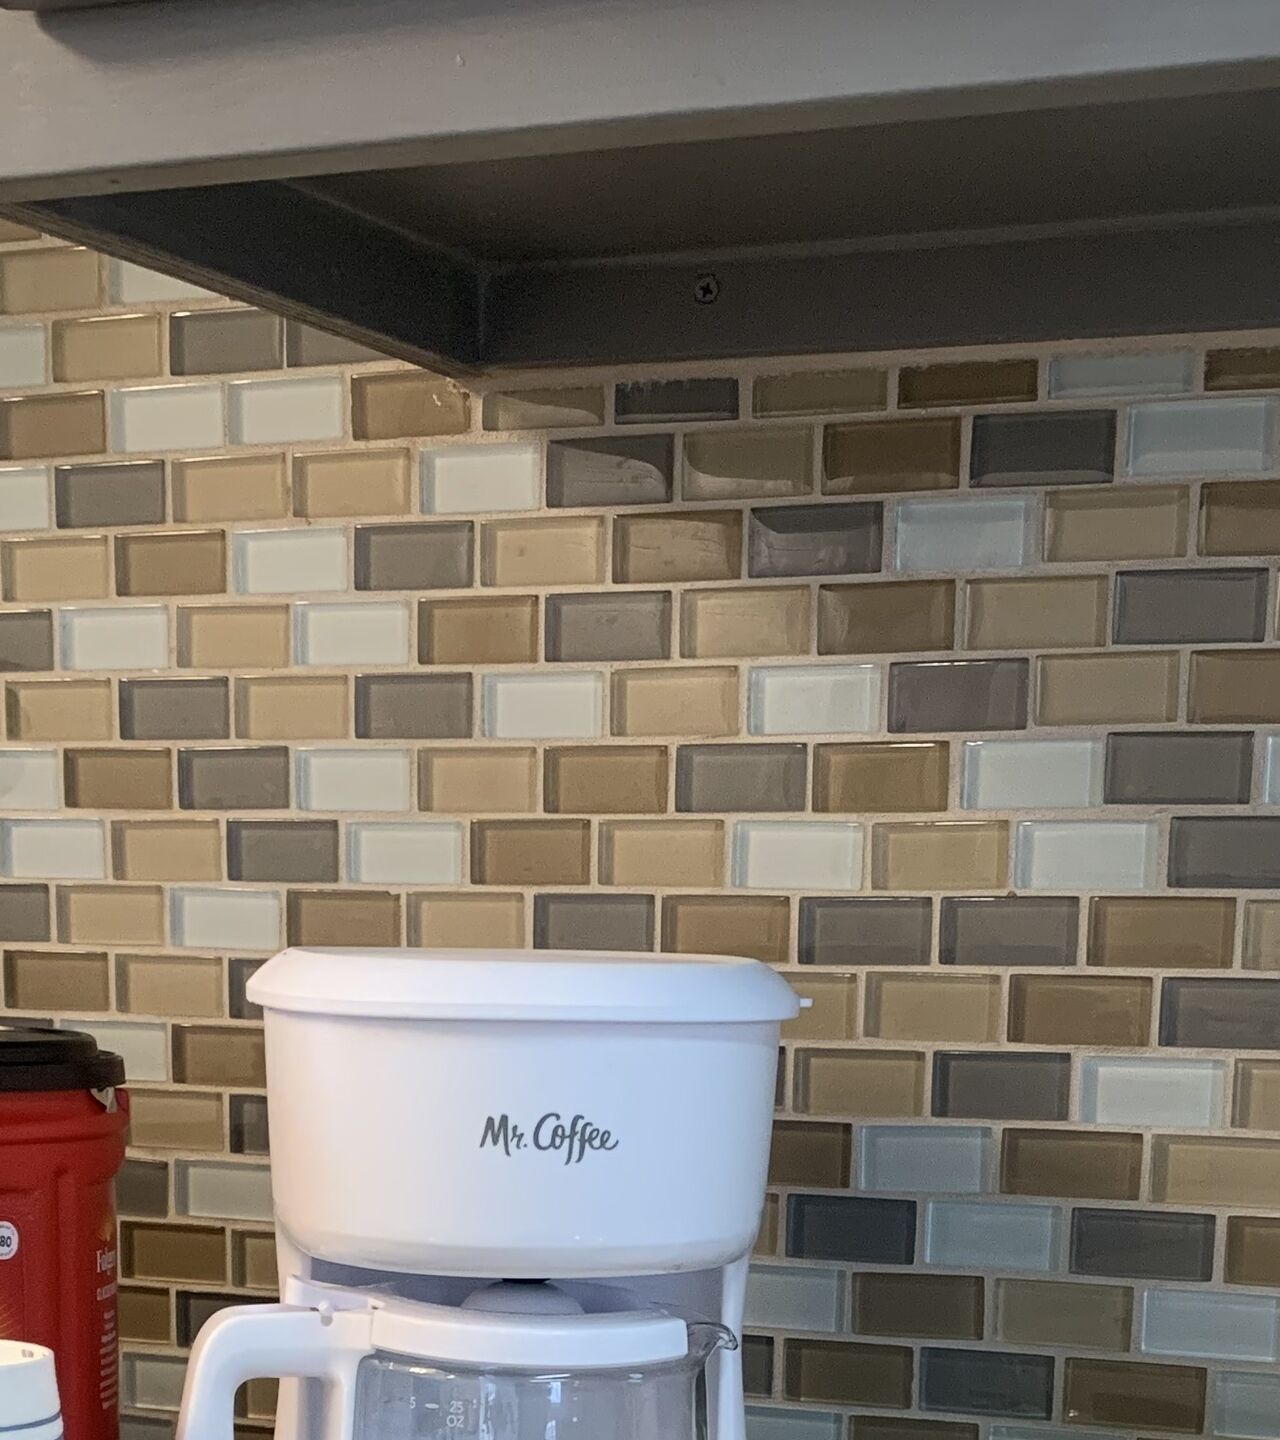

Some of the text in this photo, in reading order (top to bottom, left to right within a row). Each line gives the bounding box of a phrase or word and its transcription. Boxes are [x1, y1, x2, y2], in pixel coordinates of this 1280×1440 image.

[479, 1112, 619, 1166] Mr. Coffee
[408, 1396, 464, 1414] 5 25
[446, 1415, 464, 1428] OZ
